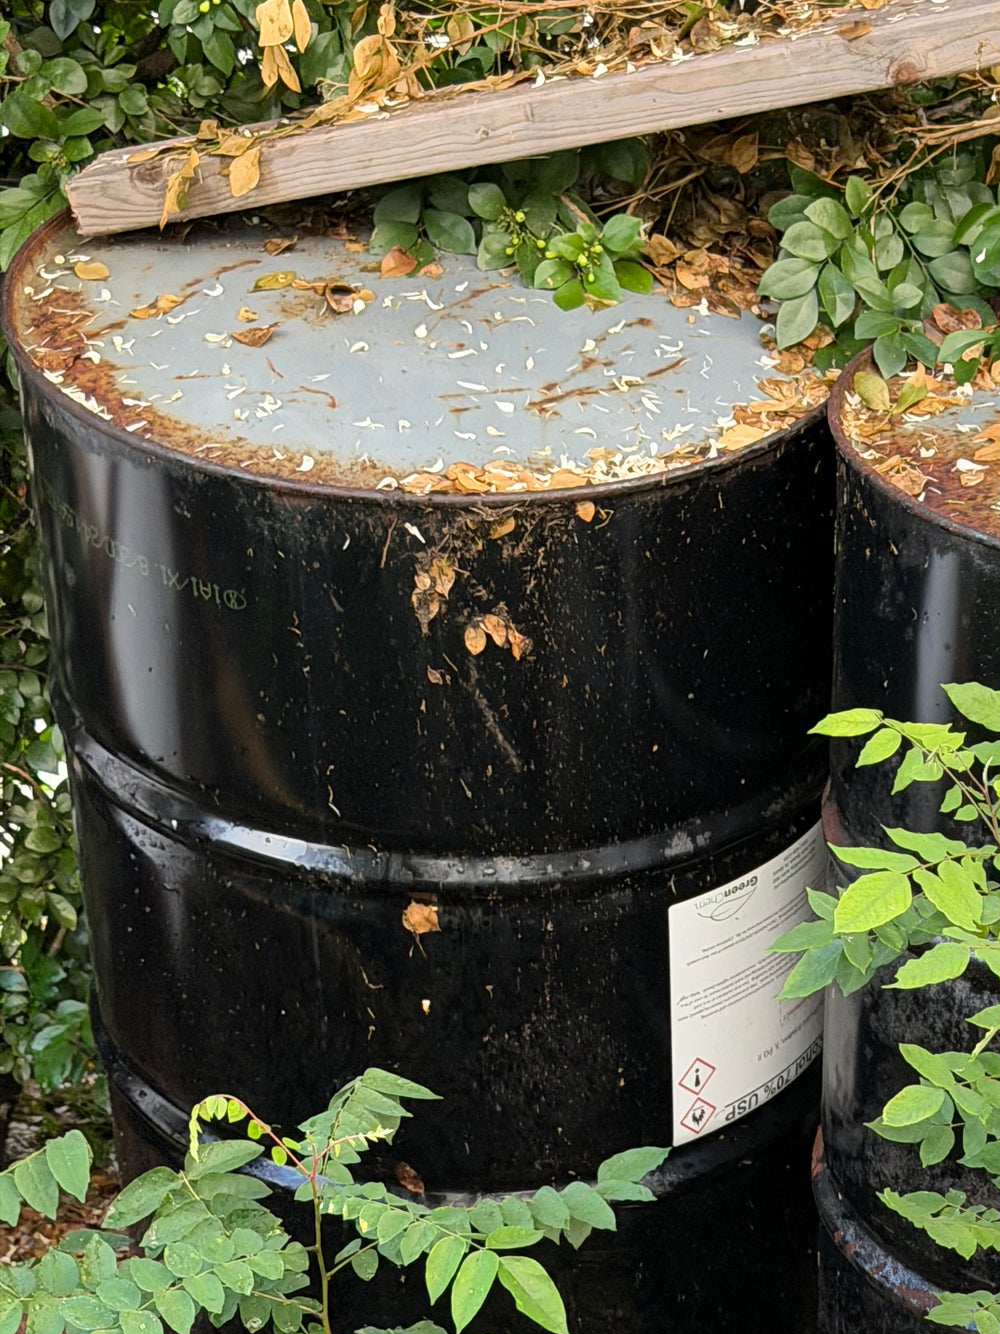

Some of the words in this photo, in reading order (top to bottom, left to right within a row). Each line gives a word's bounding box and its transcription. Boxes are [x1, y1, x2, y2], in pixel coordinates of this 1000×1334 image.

[694, 876, 759, 909] GreenChem
[764, 1069, 791, 1098] 70%
[725, 1093, 759, 1121] USP
